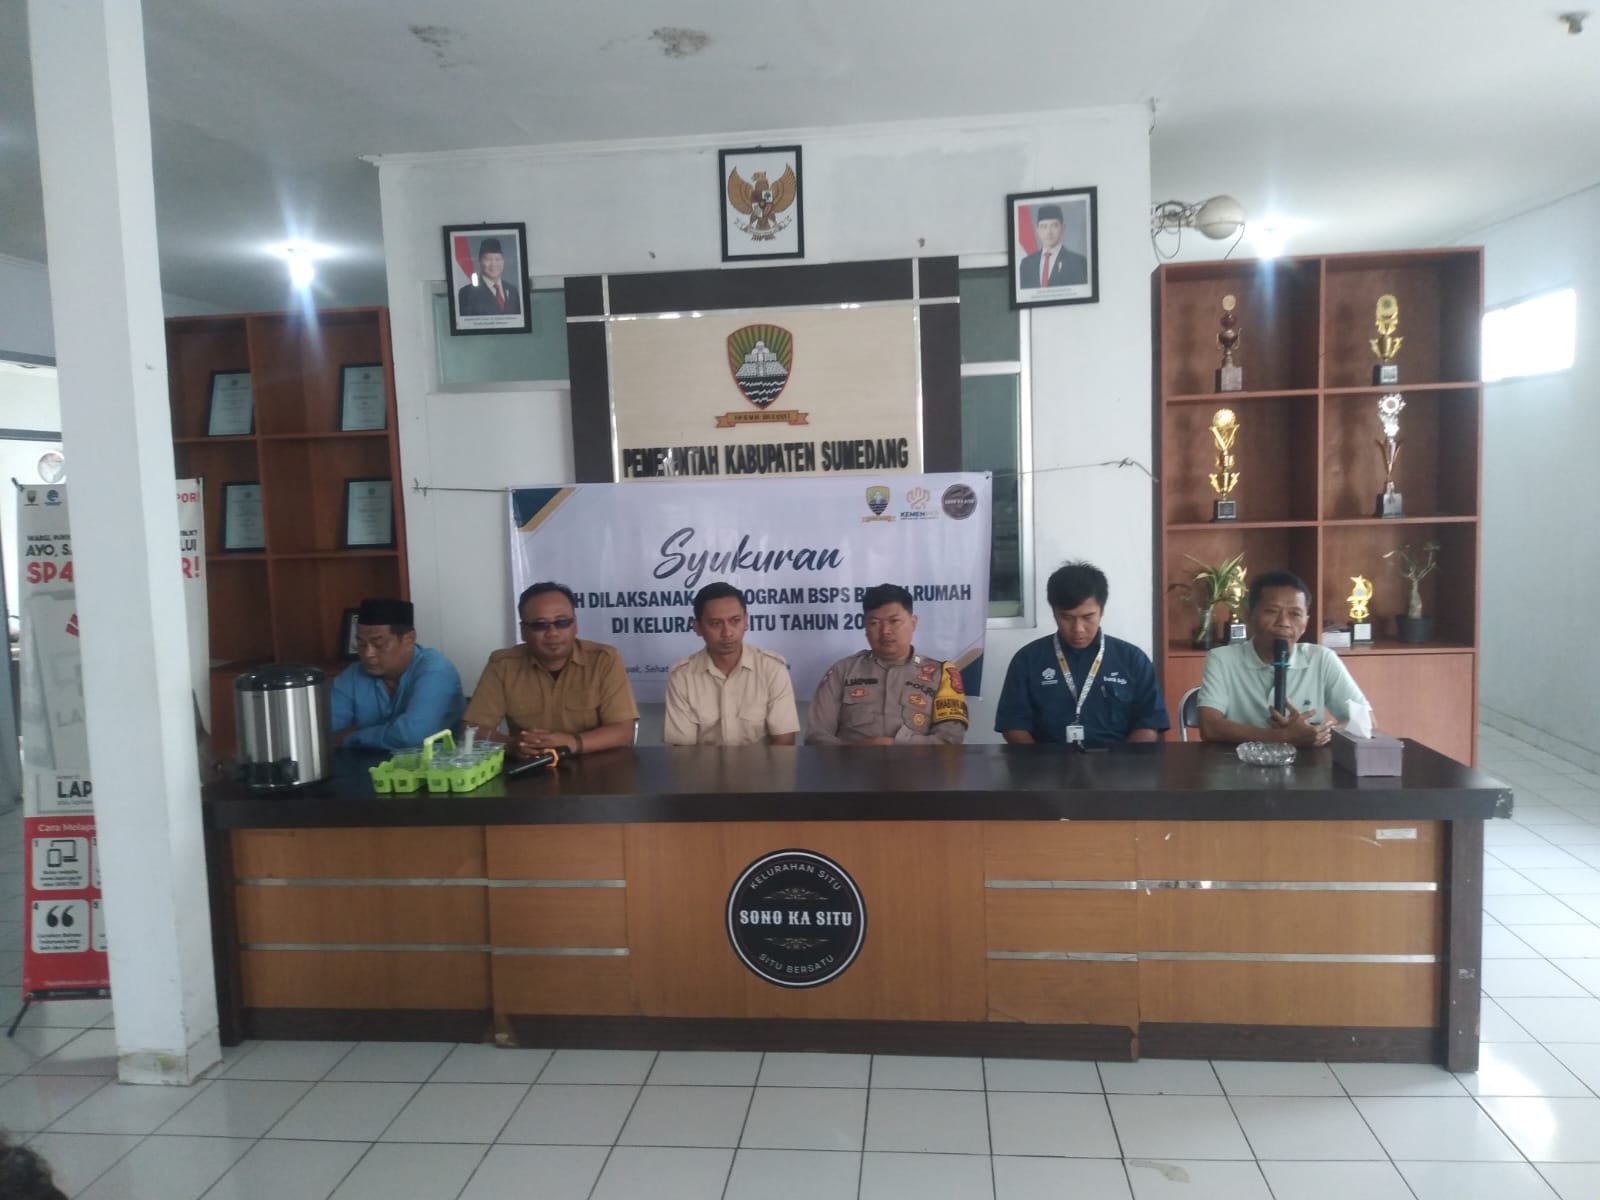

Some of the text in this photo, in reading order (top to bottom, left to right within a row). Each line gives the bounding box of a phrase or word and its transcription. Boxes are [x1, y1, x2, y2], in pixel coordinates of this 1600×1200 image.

[725, 441, 815, 473] KABUPATEN
[822, 437, 908, 471] SUMEDANG
[61, 543, 72, 556] S
[653, 527, 843, 589] Syukuran
[26, 561, 73, 584] SP4
[181, 555, 200, 578] R!
[589, 590, 695, 608] DILAKSANAK
[743, 588, 804, 605] OGRAM
[809, 587, 849, 604] BSPS
[913, 584, 971, 601] RUMAH
[612, 612, 865, 633] DI KELURA ITU TAHUN 20
[57, 781, 93, 798] LAP
[750, 863, 842, 891] KELURAHAN SITU
[739, 910, 853, 926] SONO KA SITU
[758, 953, 835, 974] SITU BERSATU
